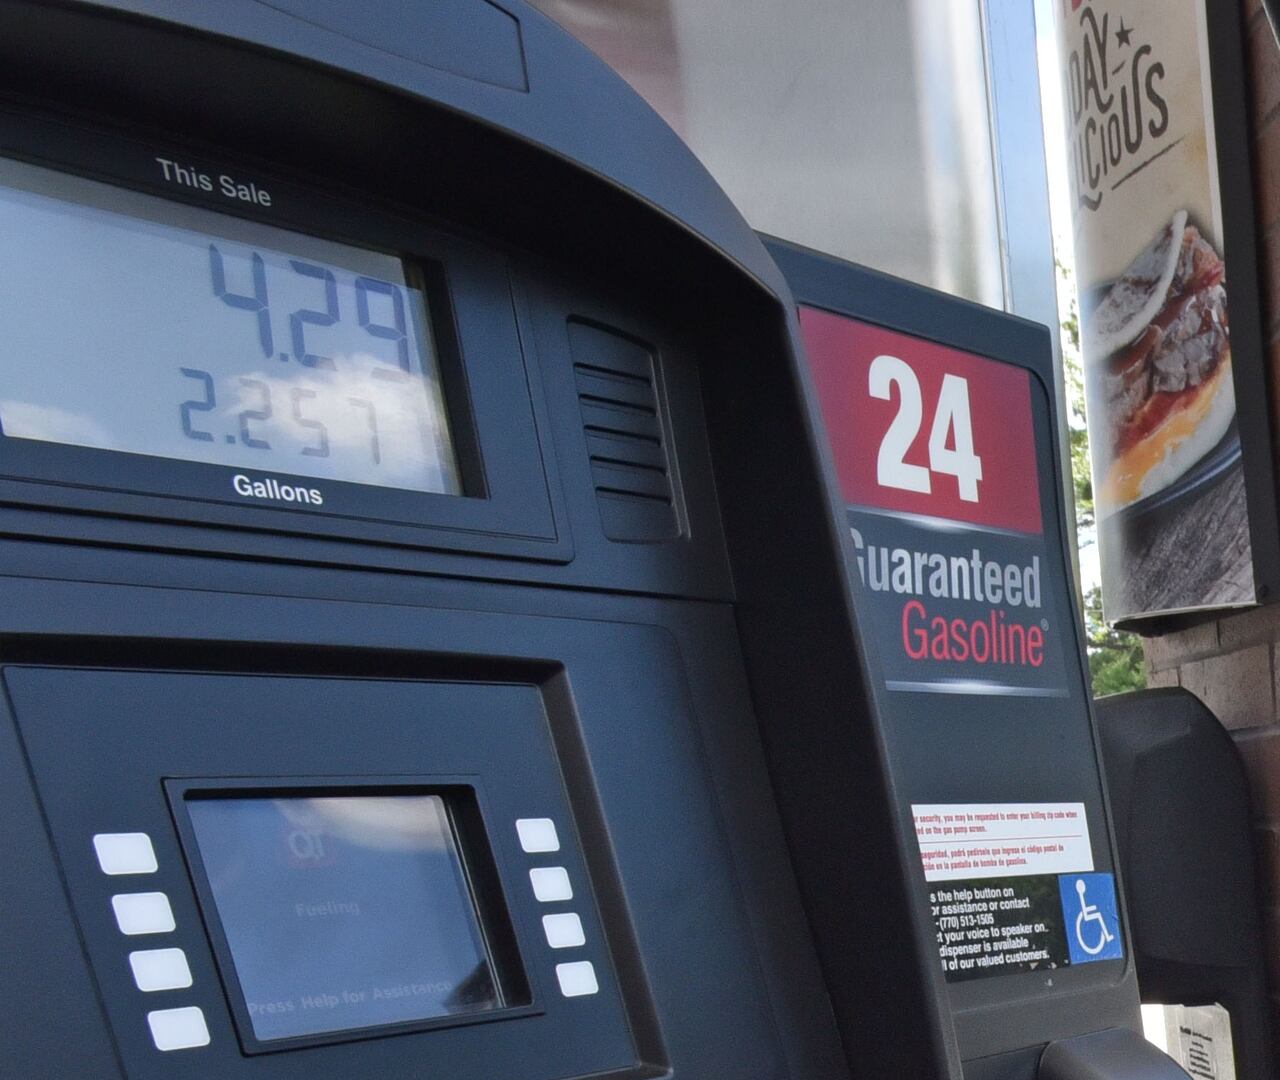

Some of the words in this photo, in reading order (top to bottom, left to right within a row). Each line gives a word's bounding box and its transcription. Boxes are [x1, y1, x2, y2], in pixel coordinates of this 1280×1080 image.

[156, 157, 213, 192] This
[220, 175, 272, 207] Sale
[208, 243, 410, 381] 4.29
[869, 355, 983, 502] 24
[232, 475, 323, 505] Gallons
[902, 600, 1044, 666] Gasoline
[937, 890, 952, 902] the
[953, 889, 972, 902] help
[974, 888, 1001, 899] button
[1003, 888, 1014, 897] on
[942, 903, 987, 915] assistance
[989, 902, 998, 910] or
[1000, 897, 1030, 910] contact
[940, 917, 959, 930] (770)
[945, 932, 965, 944] your
[966, 929, 989, 940] voice
[991, 927, 1000, 937] to
[1001, 924, 1033, 936] speaker
[940, 944, 981, 957] dispenser
[983, 941, 991, 952] is
[993, 937, 1029, 951] available
[949, 959, 958, 970] of
[960, 960, 974, 969] our
[977, 953, 1004, 966] valued
[1006, 950, 1050, 963] customers.
